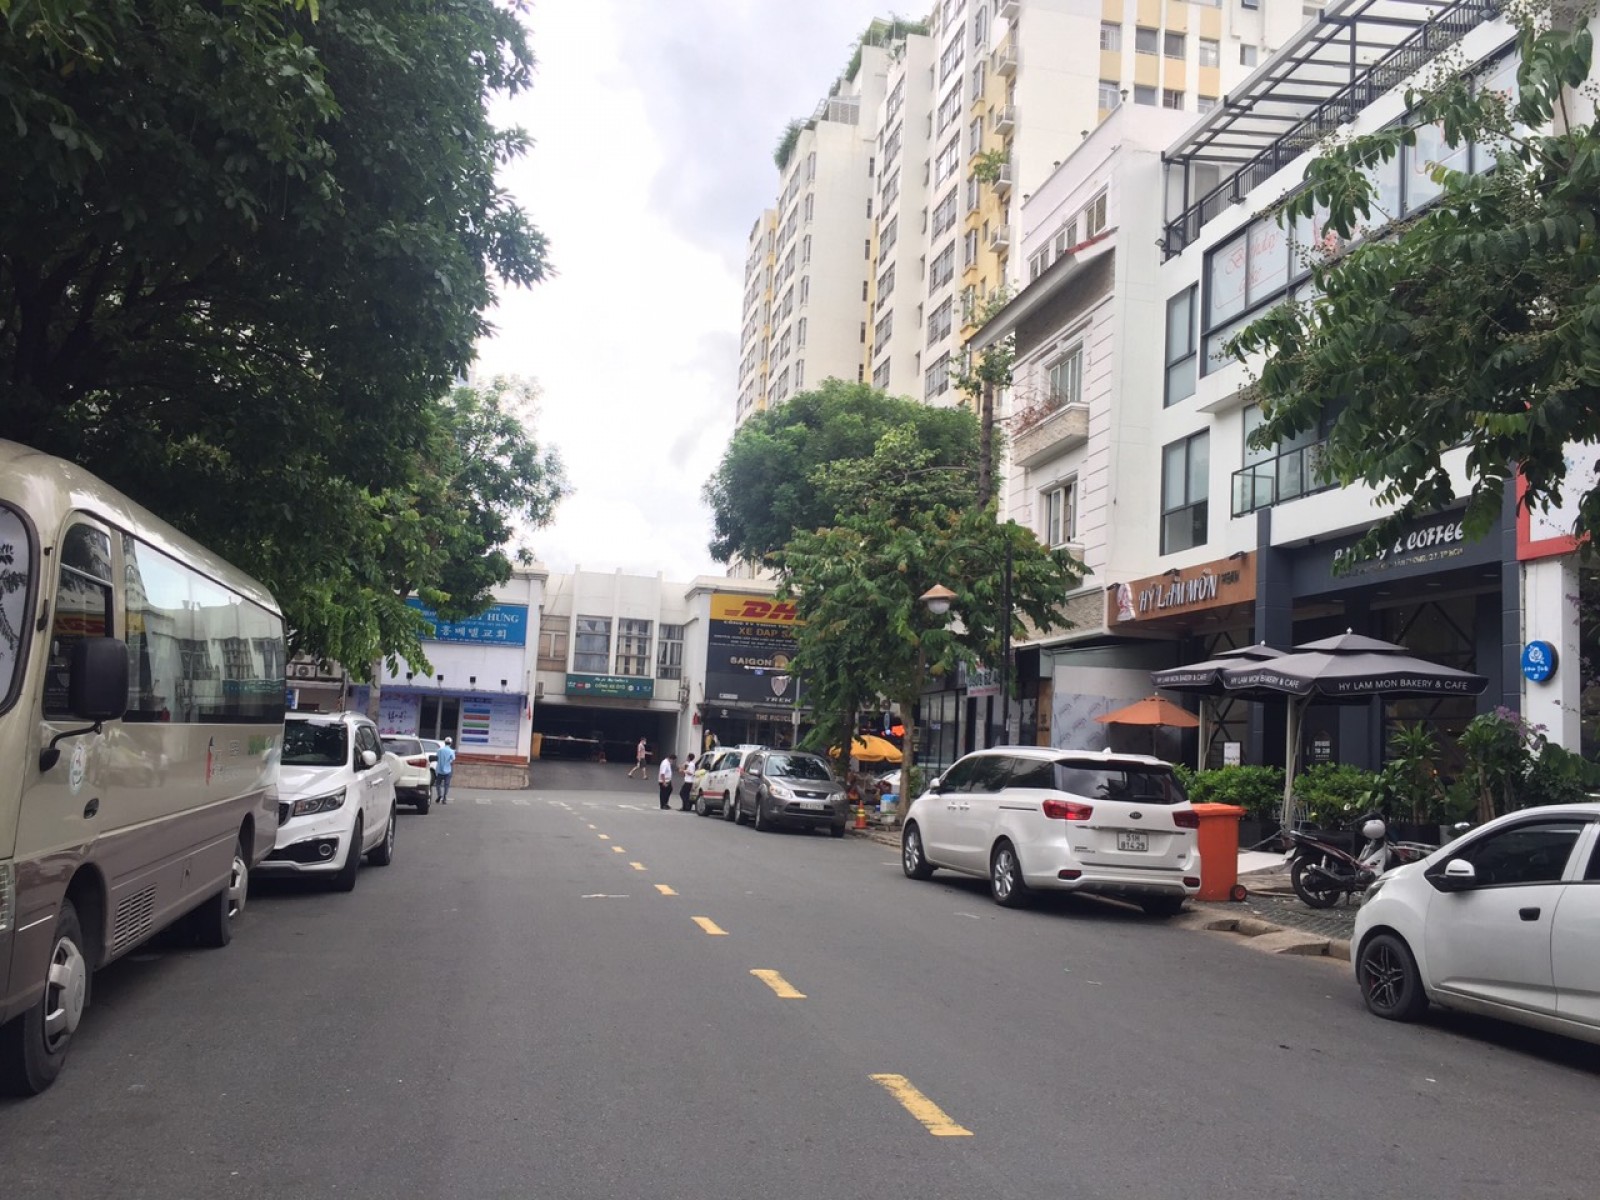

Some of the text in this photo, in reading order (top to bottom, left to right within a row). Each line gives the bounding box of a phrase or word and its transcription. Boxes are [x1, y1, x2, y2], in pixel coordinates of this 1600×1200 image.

[741, 600, 796, 620] DH
[730, 656, 772, 666] SAIGON
[1260, 674, 1279, 685] BAKERY
[1285, 678, 1300, 688] CAFE
[1338, 678, 1468, 691] HY LAM MON BAKERY & CAFE
